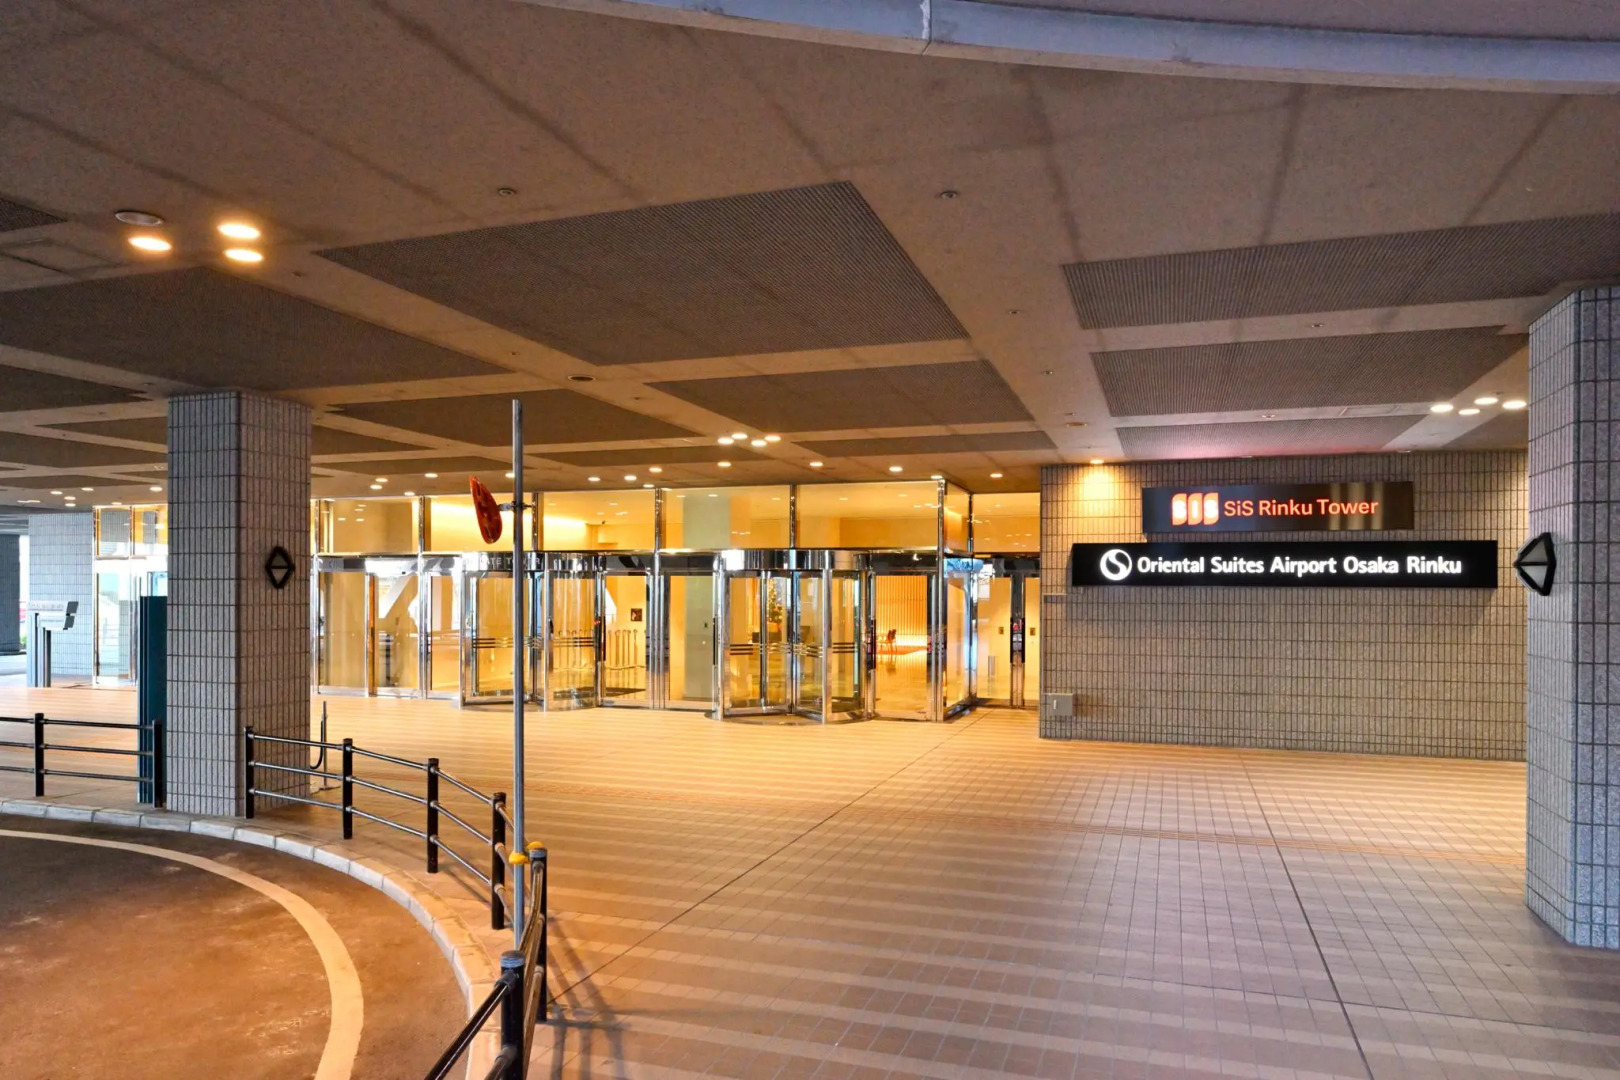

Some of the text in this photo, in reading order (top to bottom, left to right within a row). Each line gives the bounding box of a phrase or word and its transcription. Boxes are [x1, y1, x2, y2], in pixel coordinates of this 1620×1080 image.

[1224, 500, 1254, 516] SiS
[1258, 499, 1313, 516] Rinku
[1316, 498, 1379, 515] Tower
[1136, 556, 1462, 578] Oriental Suites Airport Osaka Rinku
